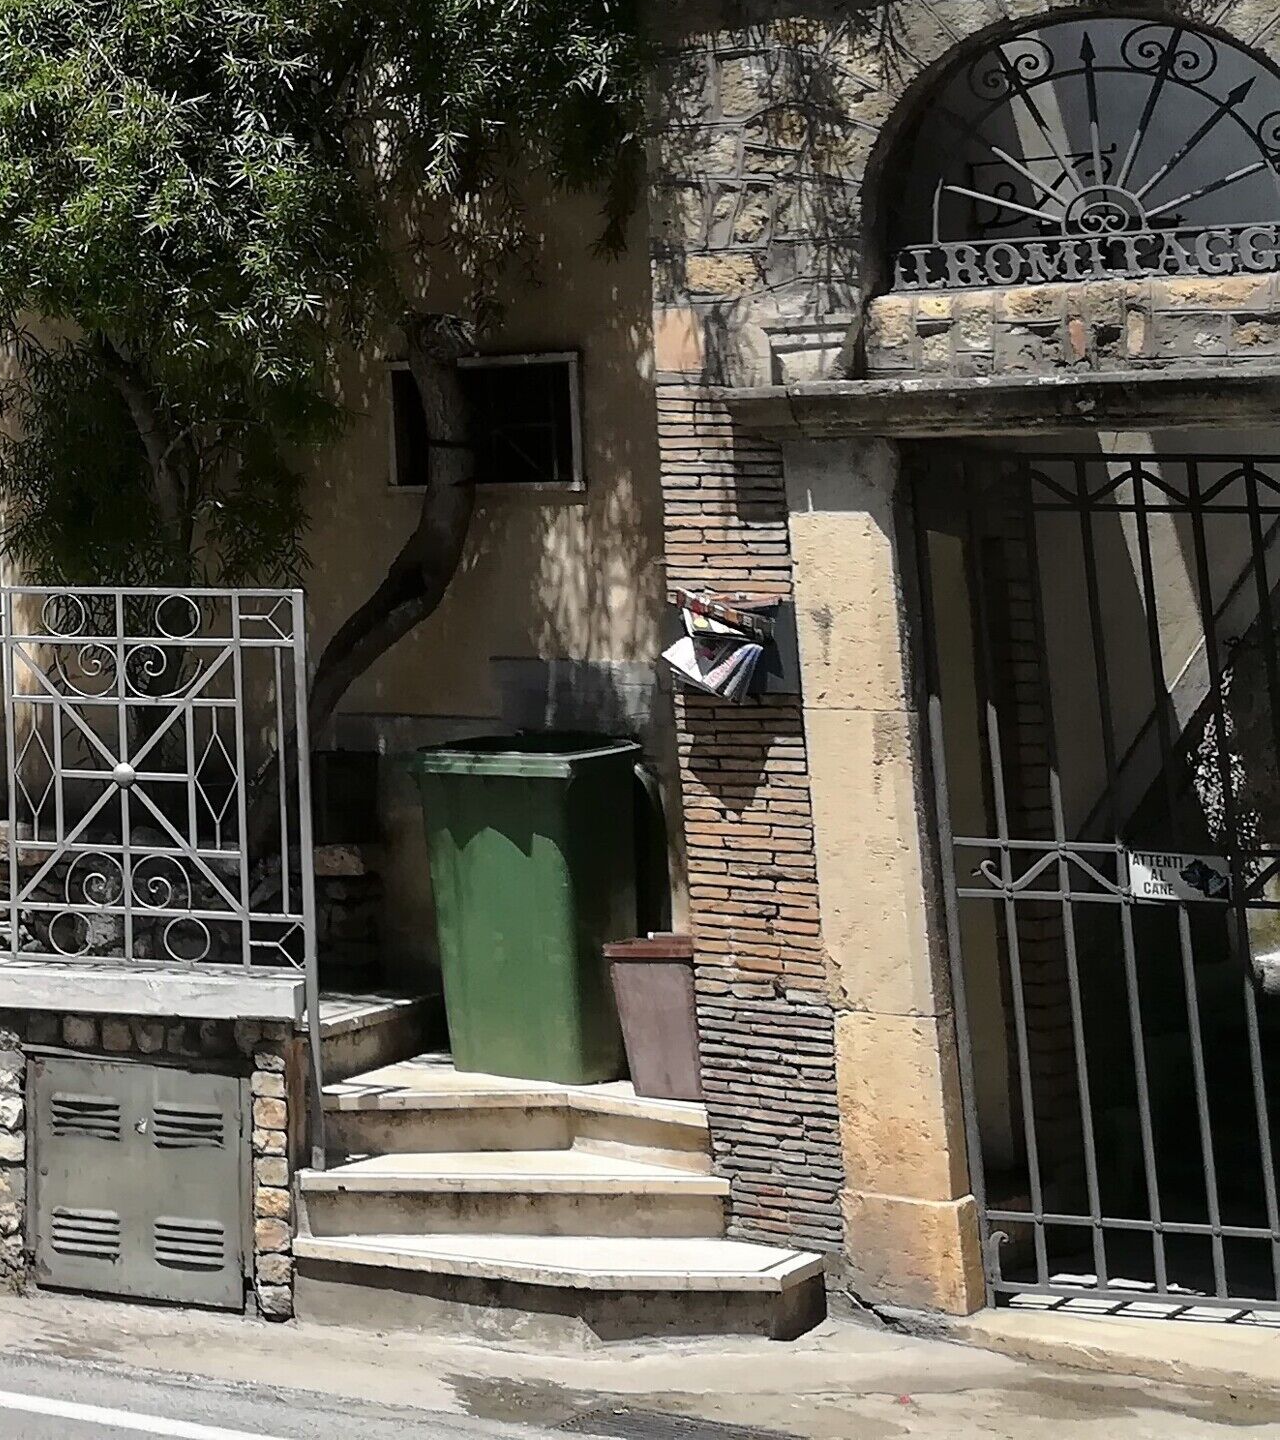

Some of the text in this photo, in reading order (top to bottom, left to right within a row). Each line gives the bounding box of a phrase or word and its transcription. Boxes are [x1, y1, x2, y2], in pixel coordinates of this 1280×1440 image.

[1132, 853, 1183, 868] ATTENTI
[1151, 868, 1167, 882] AL
[1143, 882, 1175, 895] CANE
